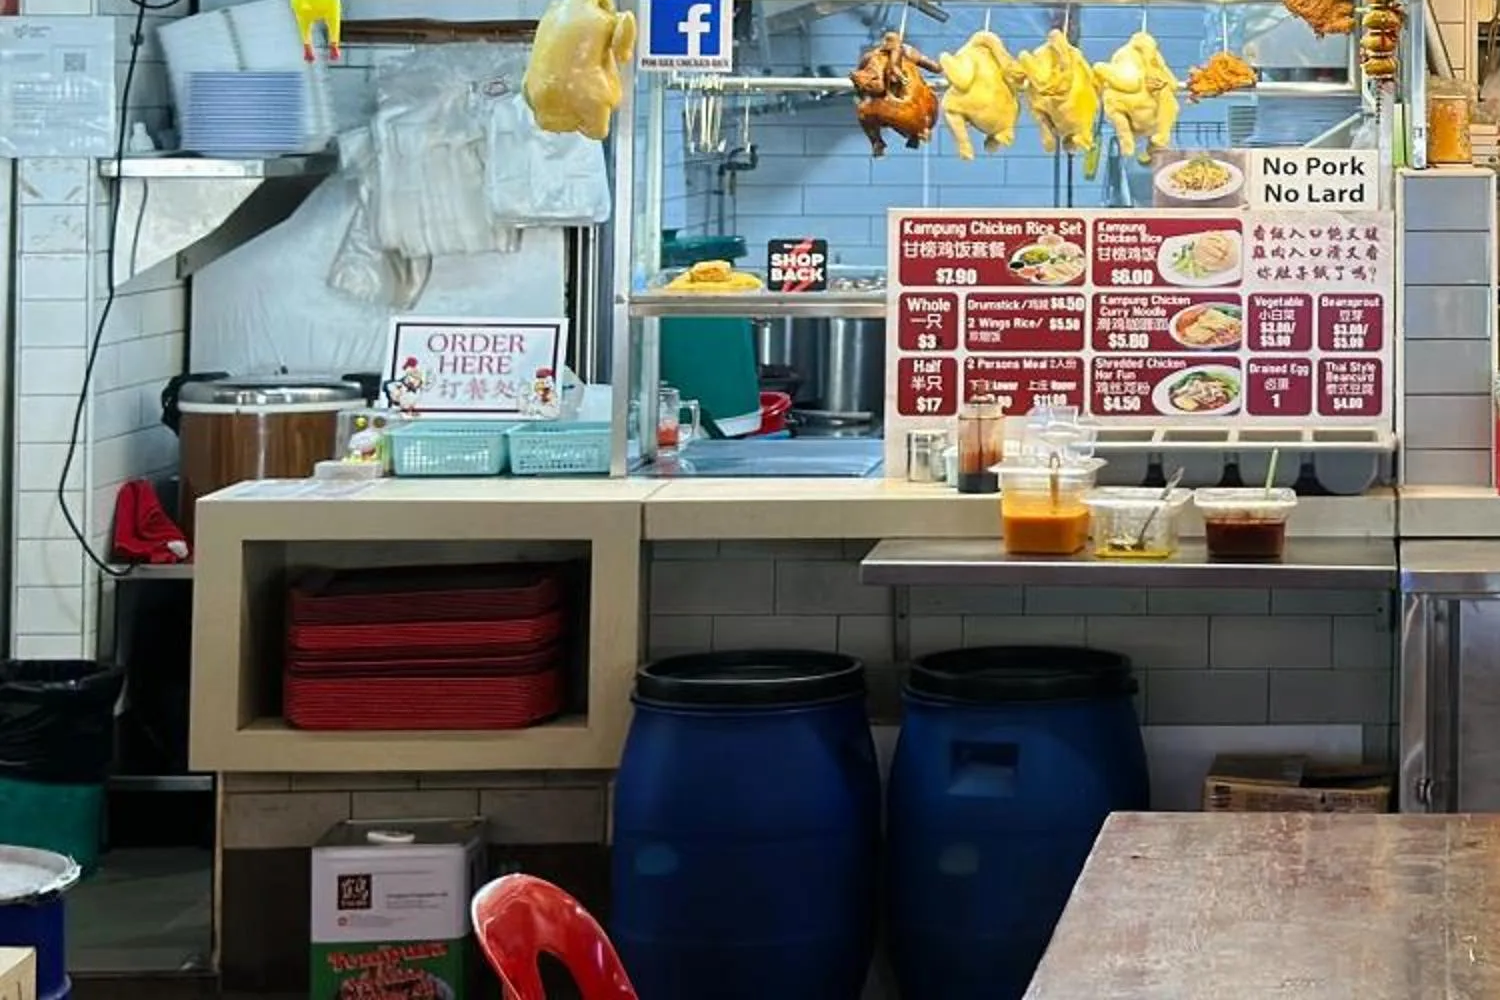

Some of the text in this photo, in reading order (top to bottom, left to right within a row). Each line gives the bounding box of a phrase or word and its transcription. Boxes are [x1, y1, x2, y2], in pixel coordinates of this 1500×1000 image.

[1263, 156, 1365, 176] No Pork
[1265, 183, 1365, 203] No Lard
[903, 221, 1083, 237] Kampung Chicken Rice Set
[771, 253, 825, 267] SHOP
[770, 267, 825, 281] BACK
[935, 267, 977, 285] $7.90
[906, 297, 951, 313] Whole
[1253, 296, 1305, 309] Vegetable
[909, 313, 943, 330] 一只
[978, 317, 1011, 331] Wings
[427, 332, 525, 354] ORDER
[438, 355, 513, 375] HERE
[913, 359, 943, 374] Half
[916, 396, 943, 413] $17
